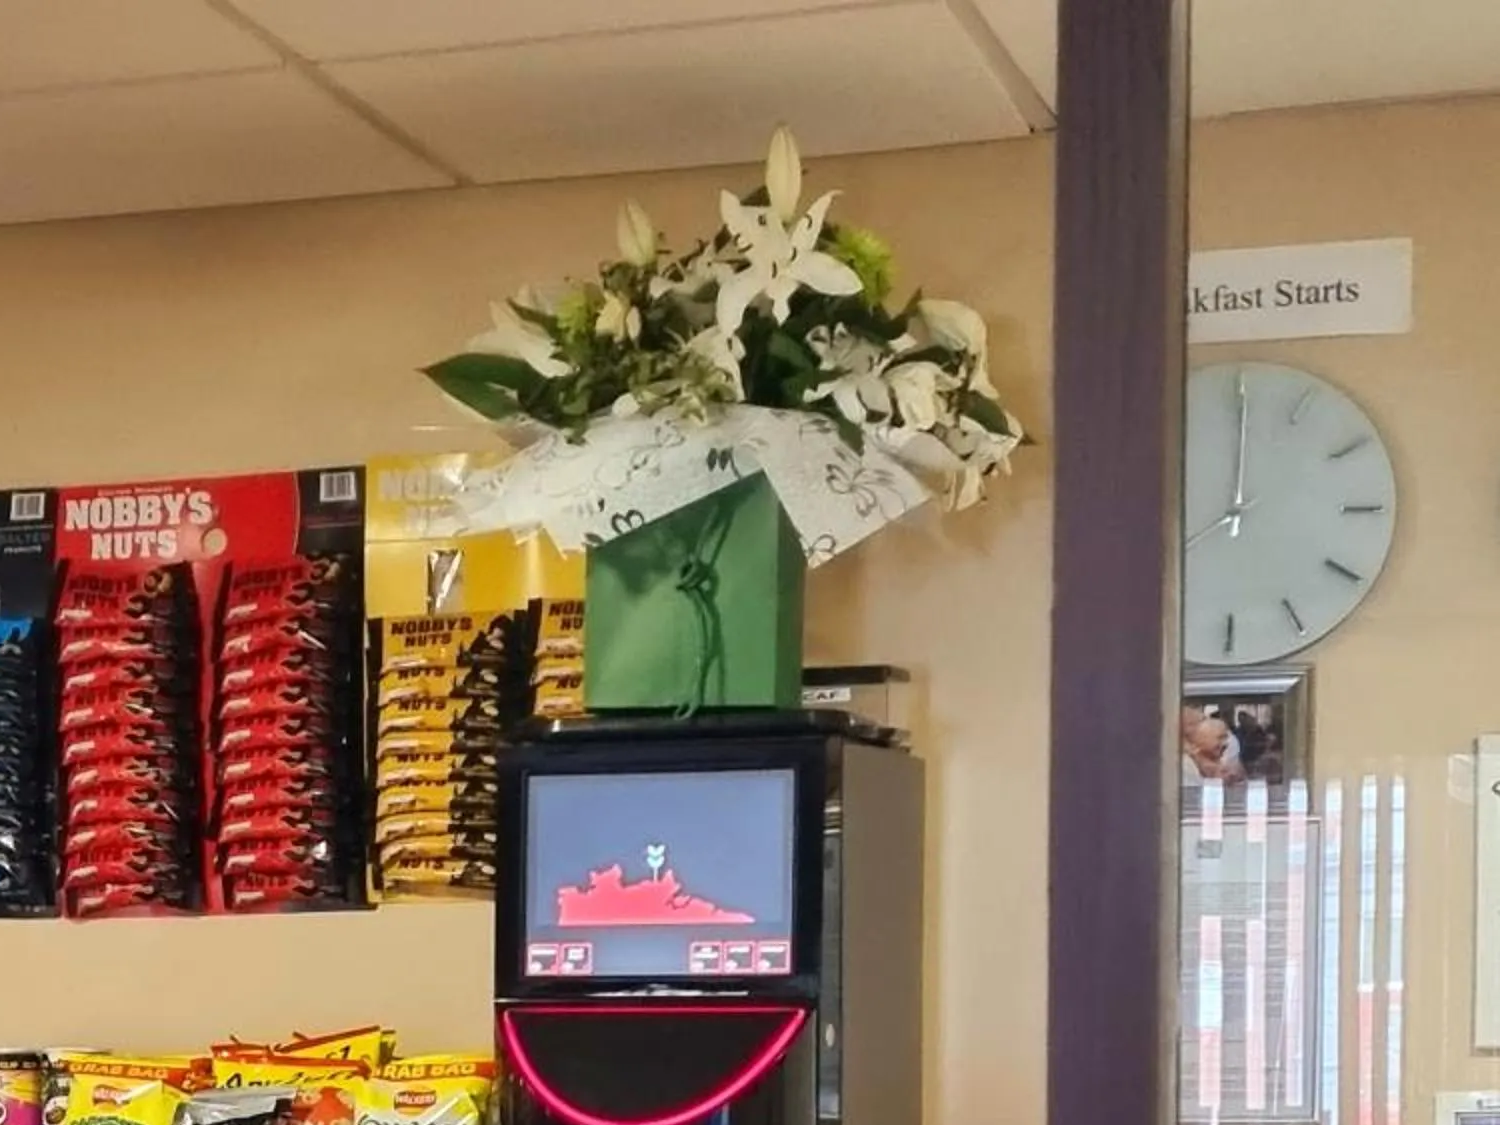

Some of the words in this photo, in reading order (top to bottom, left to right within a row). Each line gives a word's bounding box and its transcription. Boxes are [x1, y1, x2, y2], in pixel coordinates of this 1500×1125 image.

[1188, 284, 1263, 314] kfast
[1274, 279, 1360, 307] Starts
[63, 486, 214, 532] NOBBY'S
[91, 529, 178, 561] NUTS
[405, 633, 453, 647] NUTS
[398, 665, 445, 680] NUTS
[68, 1062, 124, 1075] GRAB
[128, 1067, 170, 1079] BAG
[382, 1062, 426, 1079] RAB
[431, 1062, 477, 1077] BAG
